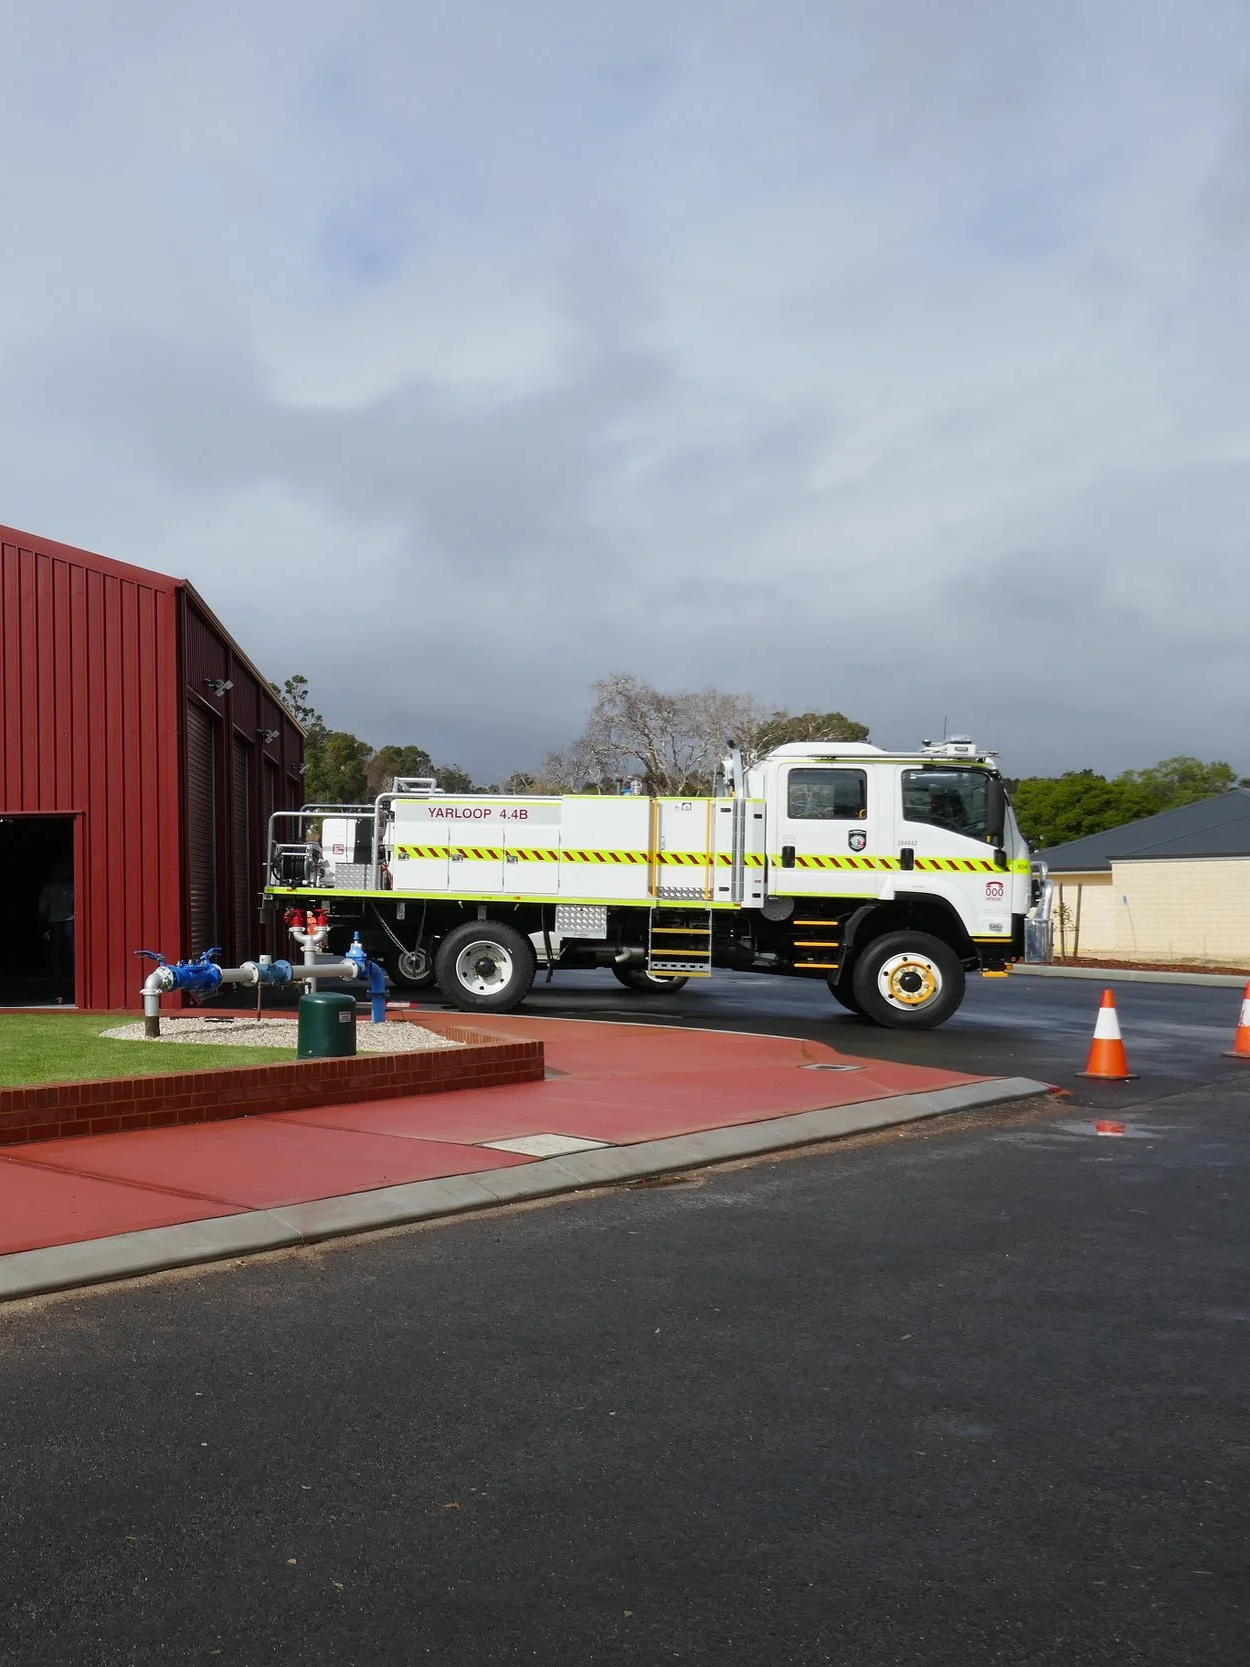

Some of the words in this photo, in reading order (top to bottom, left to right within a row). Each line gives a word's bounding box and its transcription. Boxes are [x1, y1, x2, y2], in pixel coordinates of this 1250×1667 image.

[428, 807, 492, 819] YARLOOP
[499, 809, 528, 820] 4.4B
[985, 888, 1004, 897] 000
